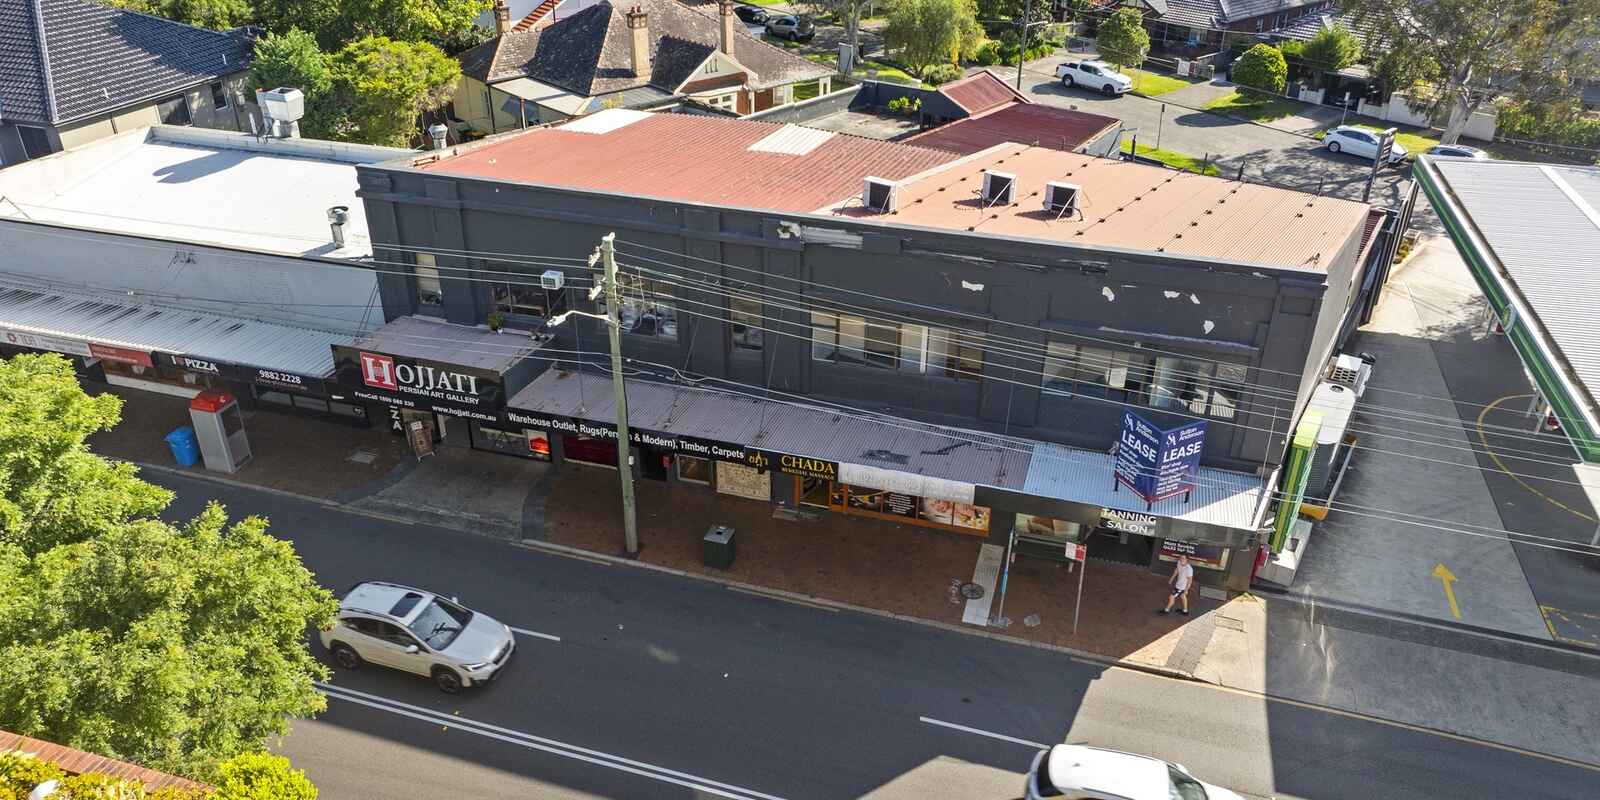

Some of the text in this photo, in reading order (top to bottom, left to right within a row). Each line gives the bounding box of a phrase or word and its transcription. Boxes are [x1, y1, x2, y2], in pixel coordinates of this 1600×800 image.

[184, 358, 219, 373] PIZZA
[259, 370, 280, 380] 9882
[280, 373, 302, 384] 2228
[362, 356, 479, 396] HOJJATI
[400, 386, 479, 406] PERSIAN ART GALLERY
[432, 404, 497, 422] www.hojjati.com.au
[508, 412, 551, 428] Warehouse
[552, 420, 578, 433] Outlet,
[634, 433, 640, 442] &
[642, 434, 678, 450] Modern),
[680, 440, 710, 454] Timber,
[712, 446, 744, 459] Carpets
[1122, 430, 1158, 462] LEASE
[1162, 440, 1202, 463] LEASE
[781, 455, 835, 474] CHADA
[1102, 508, 1157, 524] TANNING
[1106, 520, 1148, 534] SALON
